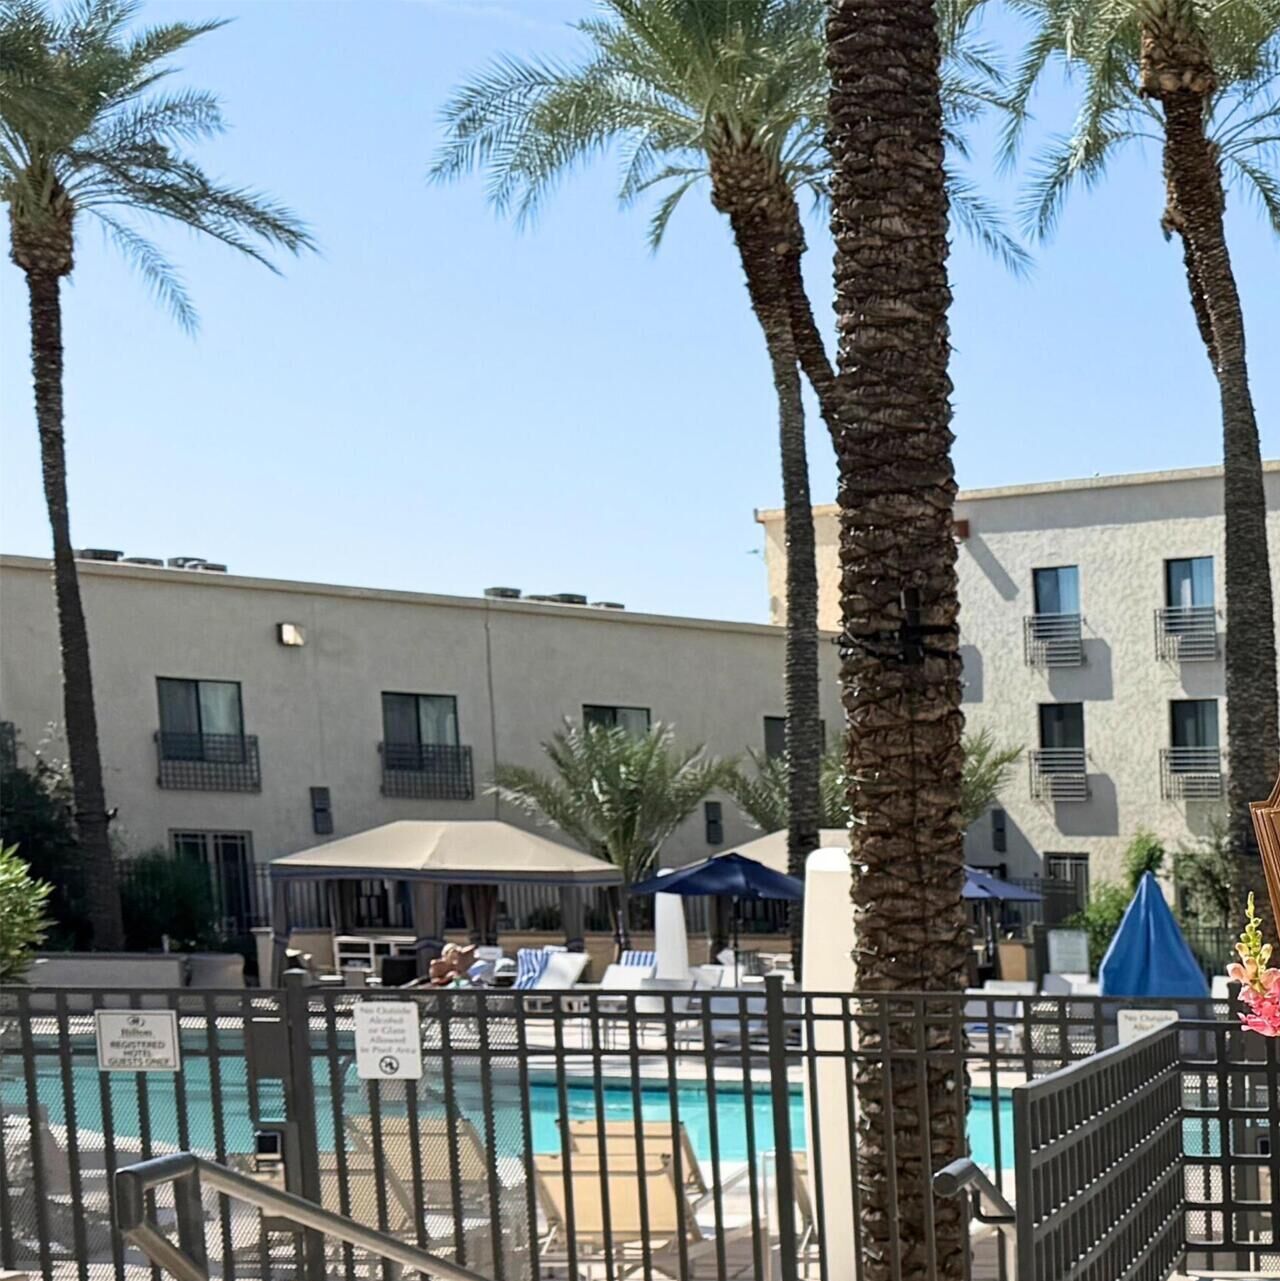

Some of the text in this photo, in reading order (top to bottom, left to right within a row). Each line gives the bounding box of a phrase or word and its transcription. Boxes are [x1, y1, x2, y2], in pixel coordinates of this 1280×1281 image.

[369, 1015, 404, 1023] Alcohol
[120, 1028, 152, 1037] Hilton
[370, 1036, 406, 1044] Allowed
[110, 1041, 166, 1049] REGISTERED
[107, 1057, 169, 1067] GUESTS ONLY
